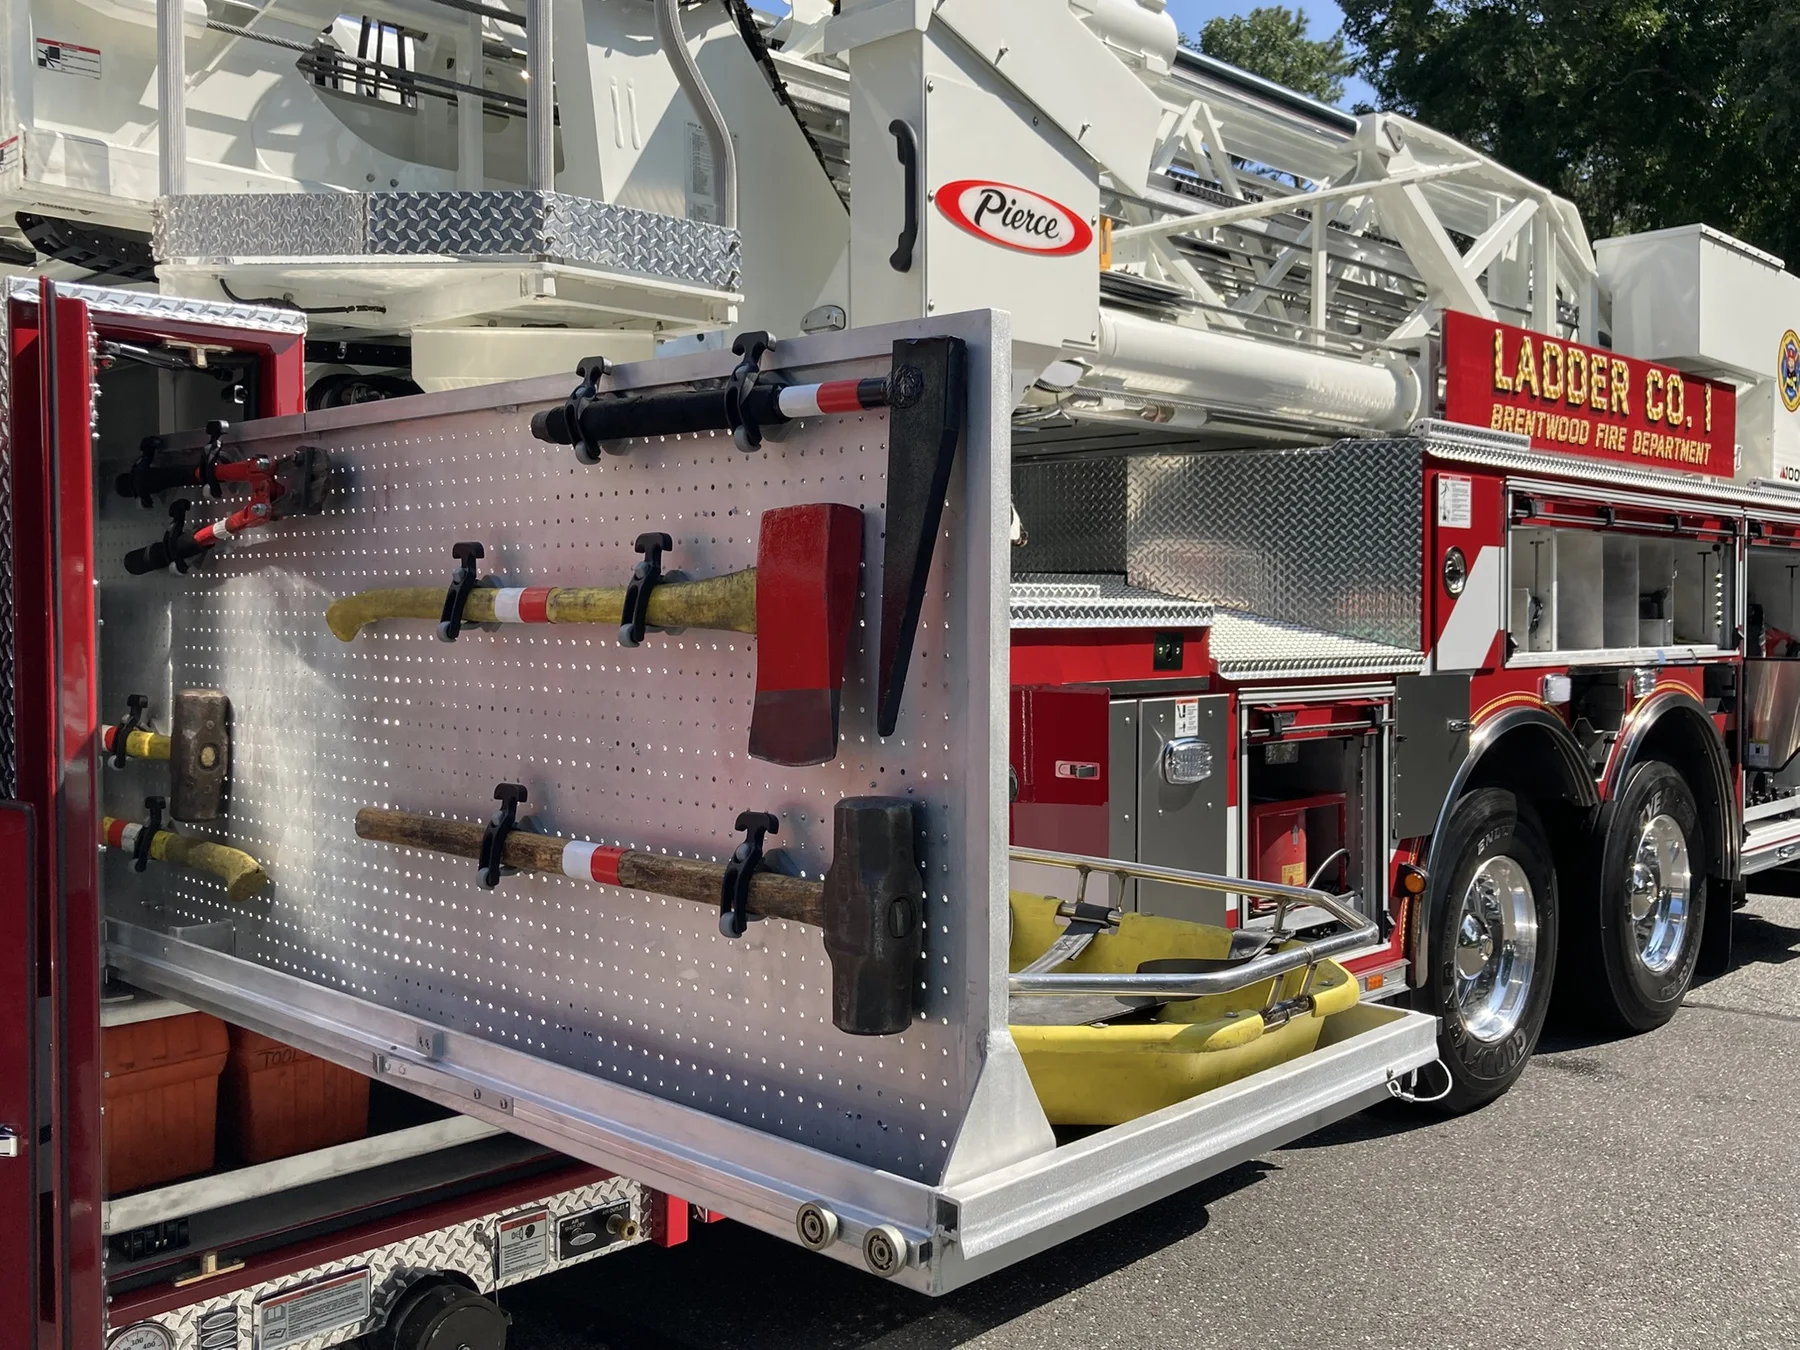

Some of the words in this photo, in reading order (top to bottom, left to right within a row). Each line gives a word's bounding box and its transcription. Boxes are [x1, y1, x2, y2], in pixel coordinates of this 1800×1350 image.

[973, 188, 1060, 239] Pierce
[1494, 328, 1630, 415] LADDER
[1646, 368, 1692, 428] CO.
[1704, 382, 1712, 432] 1
[1490, 403, 1590, 445] BRENTWOOD
[1595, 422, 1627, 452] FIRE
[1632, 429, 1712, 466] DEPARTMENT
